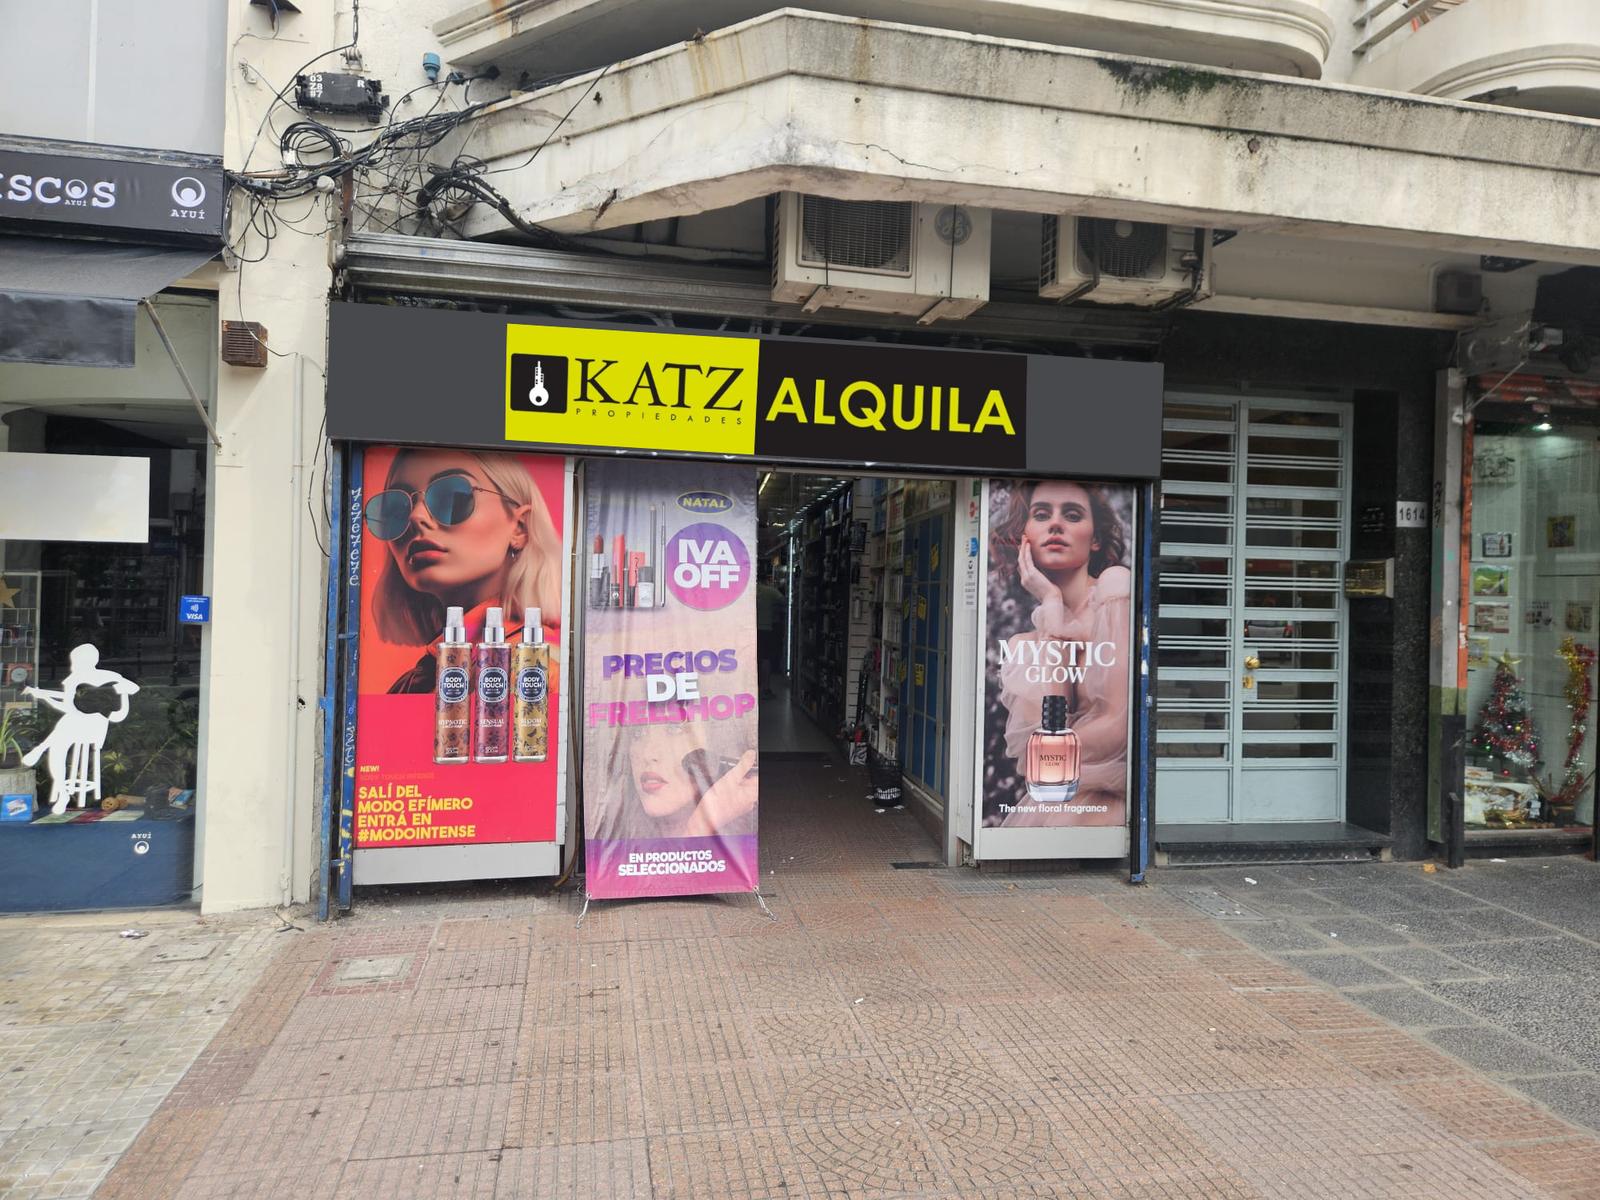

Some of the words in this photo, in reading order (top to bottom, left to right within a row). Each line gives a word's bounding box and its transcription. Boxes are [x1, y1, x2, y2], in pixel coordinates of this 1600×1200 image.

[357, 80, 365, 88] R
[0, 174, 116, 209] SCOS
[573, 358, 744, 412] KATZ
[766, 377, 1016, 435] ALQUILA
[576, 408, 742, 425] PROPIEDADES
[682, 497, 727, 508] NATAL
[1399, 507, 1425, 521] 1614
[678, 539, 737, 565] IVA
[673, 563, 741, 589] OFF
[998, 640, 1116, 667] MYSTIC
[602, 649, 738, 680] PRECIOS
[1025, 666, 1088, 684] GLOW
[647, 672, 700, 703] DE
[360, 765, 380, 773] NEW!
[358, 783, 392, 799] SALÍ
[396, 785, 422, 798] DEL
[358, 799, 404, 813] MODO
[408, 796, 473, 812] EFÍMERO
[998, 804, 1016, 813] The
[1039, 804, 1062, 813] floral
[1064, 804, 1108, 815] fragrance
[358, 811, 407, 827] ENTRÁ
[412, 813, 432, 826] EN
[357, 825, 476, 842] #MODOINTENSE
[629, 853, 644, 863] EN
[645, 850, 712, 862] PRODUCTOS
[618, 860, 726, 876] SELECCIONADOS
